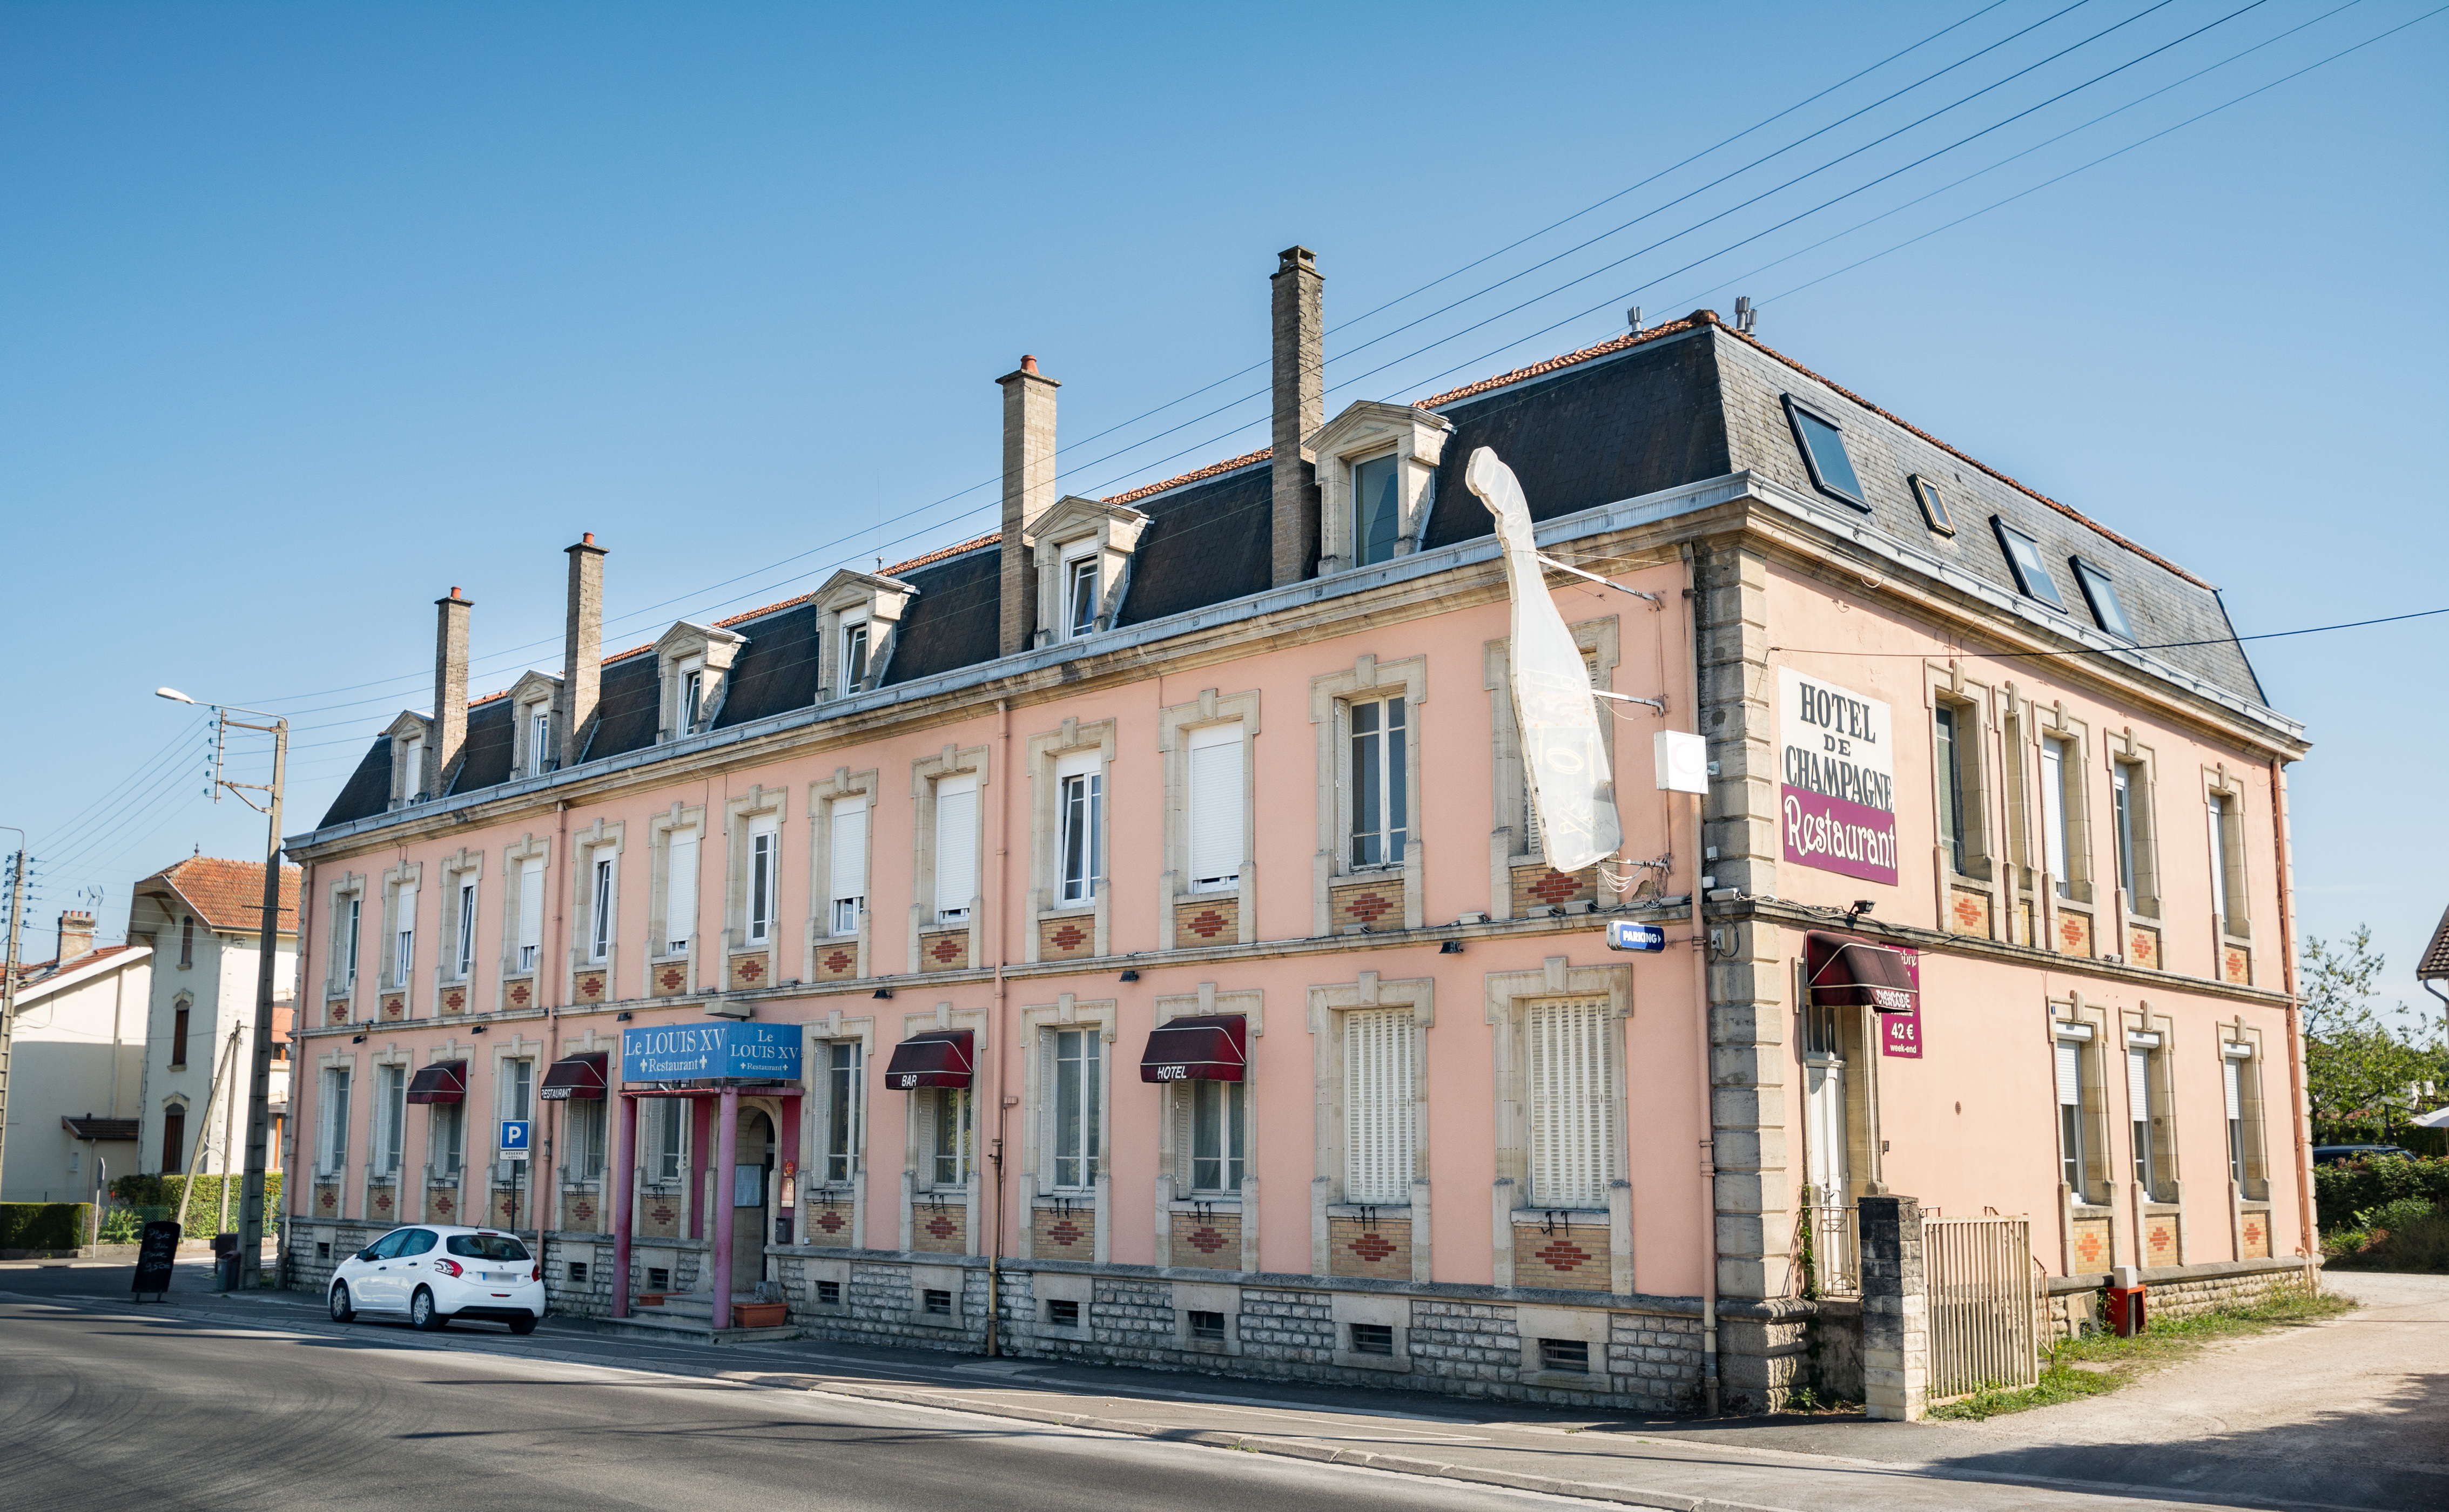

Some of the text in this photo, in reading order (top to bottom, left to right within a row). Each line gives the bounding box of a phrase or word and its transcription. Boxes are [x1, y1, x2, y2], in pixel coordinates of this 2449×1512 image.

[1799, 681, 1876, 744] HOTEL
[1824, 733, 1851, 757] DE
[1785, 745, 1893, 811] CHAMPAGNE
[1784, 795, 1896, 870] Restaurant
[1623, 930, 1657, 944] PARKING
[1875, 989, 1911, 1009] DIGICODE
[758, 1029, 773, 1043] Le
[1891, 1022, 1914, 1041] 42 €
[624, 1028, 726, 1056] Le LOUIS XV
[1890, 1043, 1917, 1054] week-end
[730, 1044, 799, 1059] LOUIS XV
[648, 1058, 698, 1072] Restaurant
[747, 1062, 782, 1071] Restaurant
[1157, 1065, 1187, 1079] HOTEL
[901, 1074, 917, 1087] BAR
[541, 1088, 571, 1099] RESTAURANT
[508, 1126, 522, 1144] P
[787, 1182, 793, 1191] H
[146, 1227, 171, 1240] Plat
